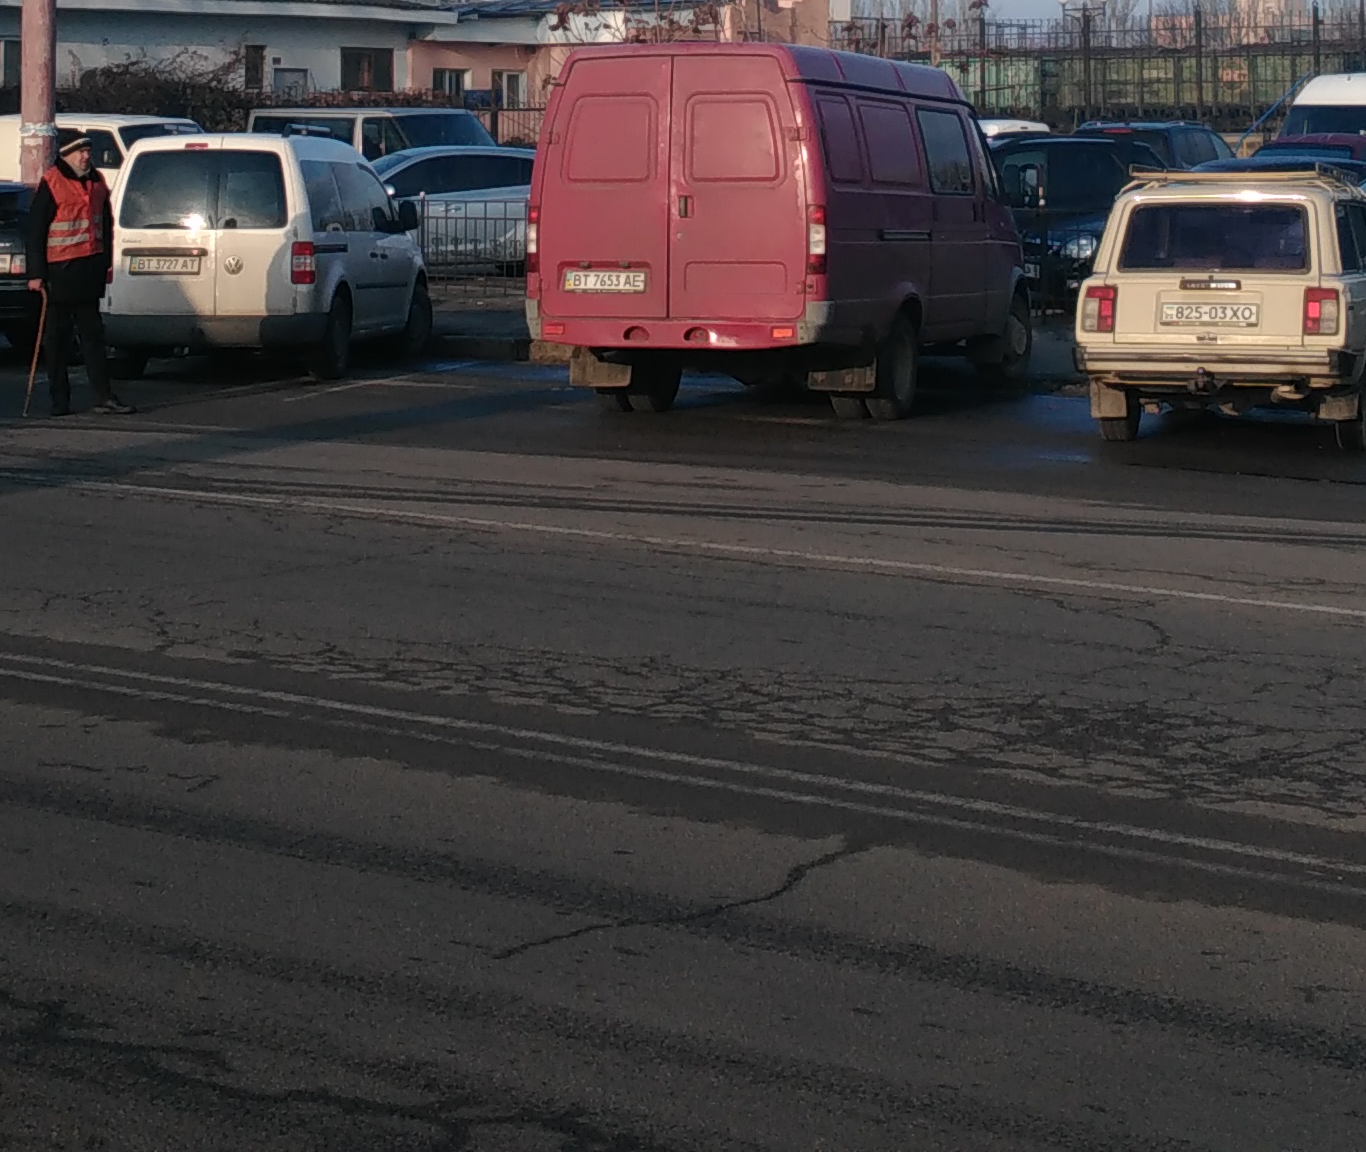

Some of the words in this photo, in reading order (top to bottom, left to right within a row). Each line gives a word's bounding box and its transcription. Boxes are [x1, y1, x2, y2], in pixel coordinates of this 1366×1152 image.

[137, 258, 154, 270] BT
[155, 259, 179, 270] 3727
[181, 259, 197, 270] AT
[573, 274, 591, 287] BT
[593, 274, 621, 287] 7653
[623, 274, 642, 288] AE
